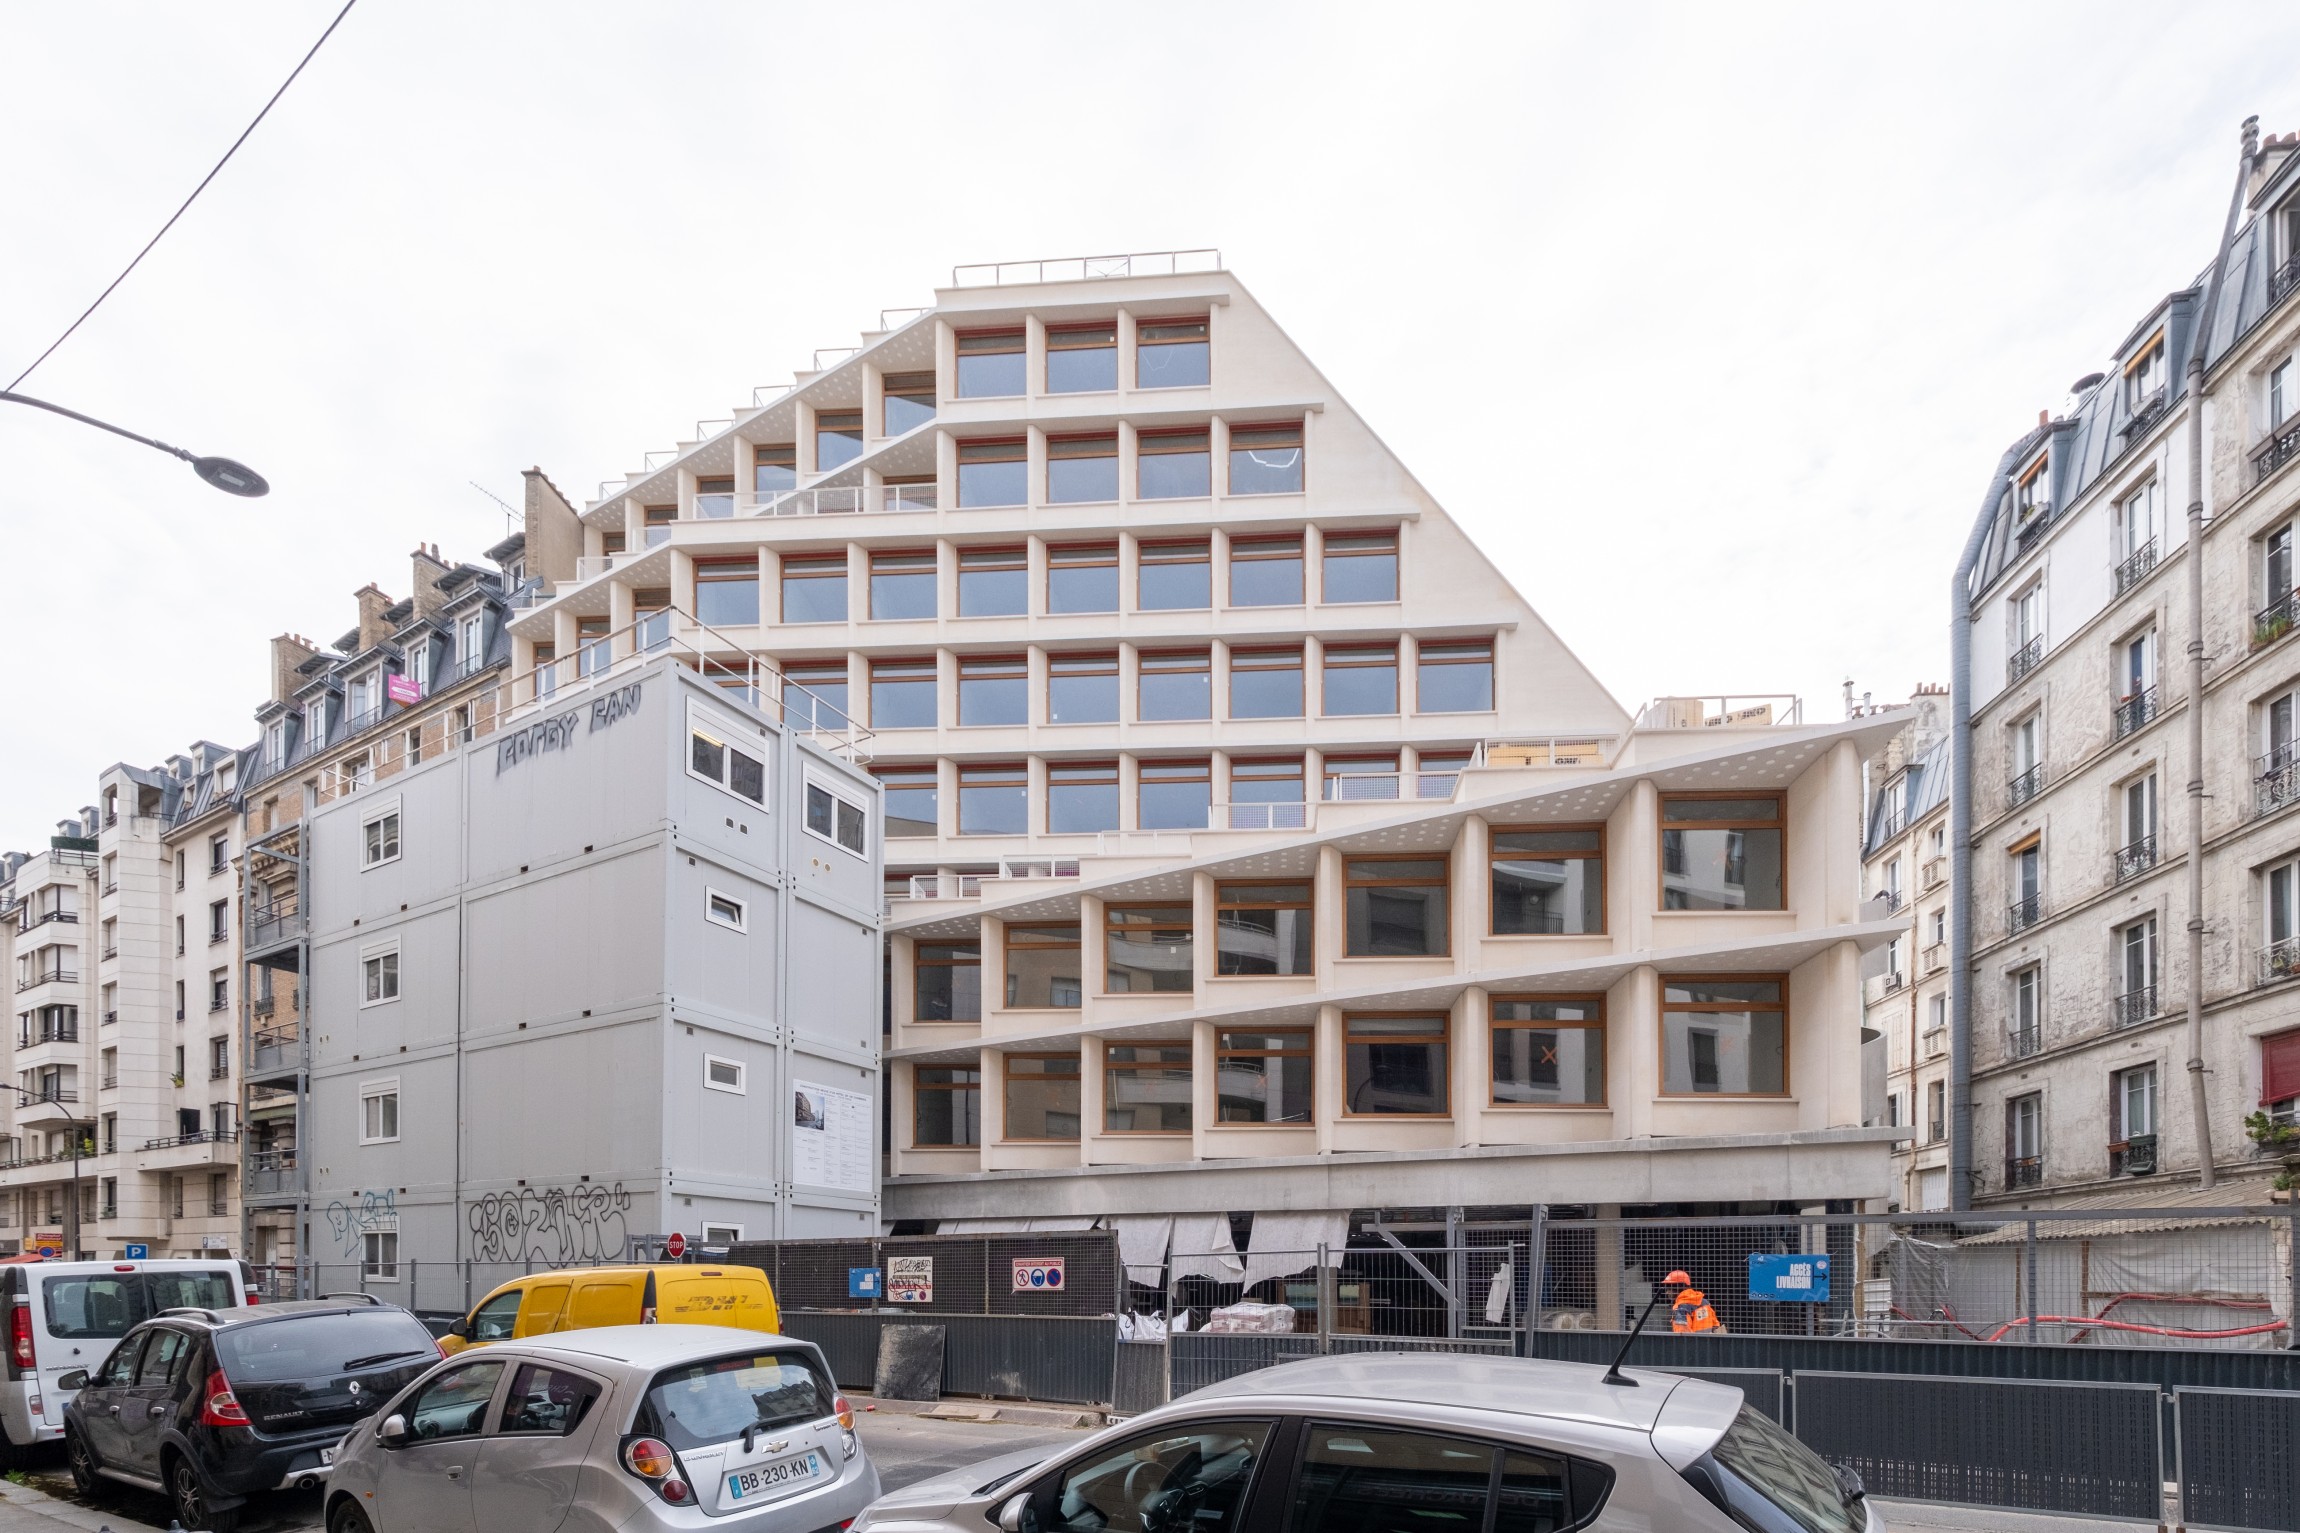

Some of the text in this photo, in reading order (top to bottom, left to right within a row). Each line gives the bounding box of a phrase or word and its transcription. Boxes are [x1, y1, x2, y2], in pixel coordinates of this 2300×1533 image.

[670, 1241, 683, 1249] STOP
[131, 1247, 142, 1257] P
[1789, 1262, 1811, 1276] ACCÈS
[1776, 1275, 1811, 1289] LIVRAISON
[263, 1410, 304, 1421] RENAULT
[740, 1459, 809, 1491] BB-230-KN
